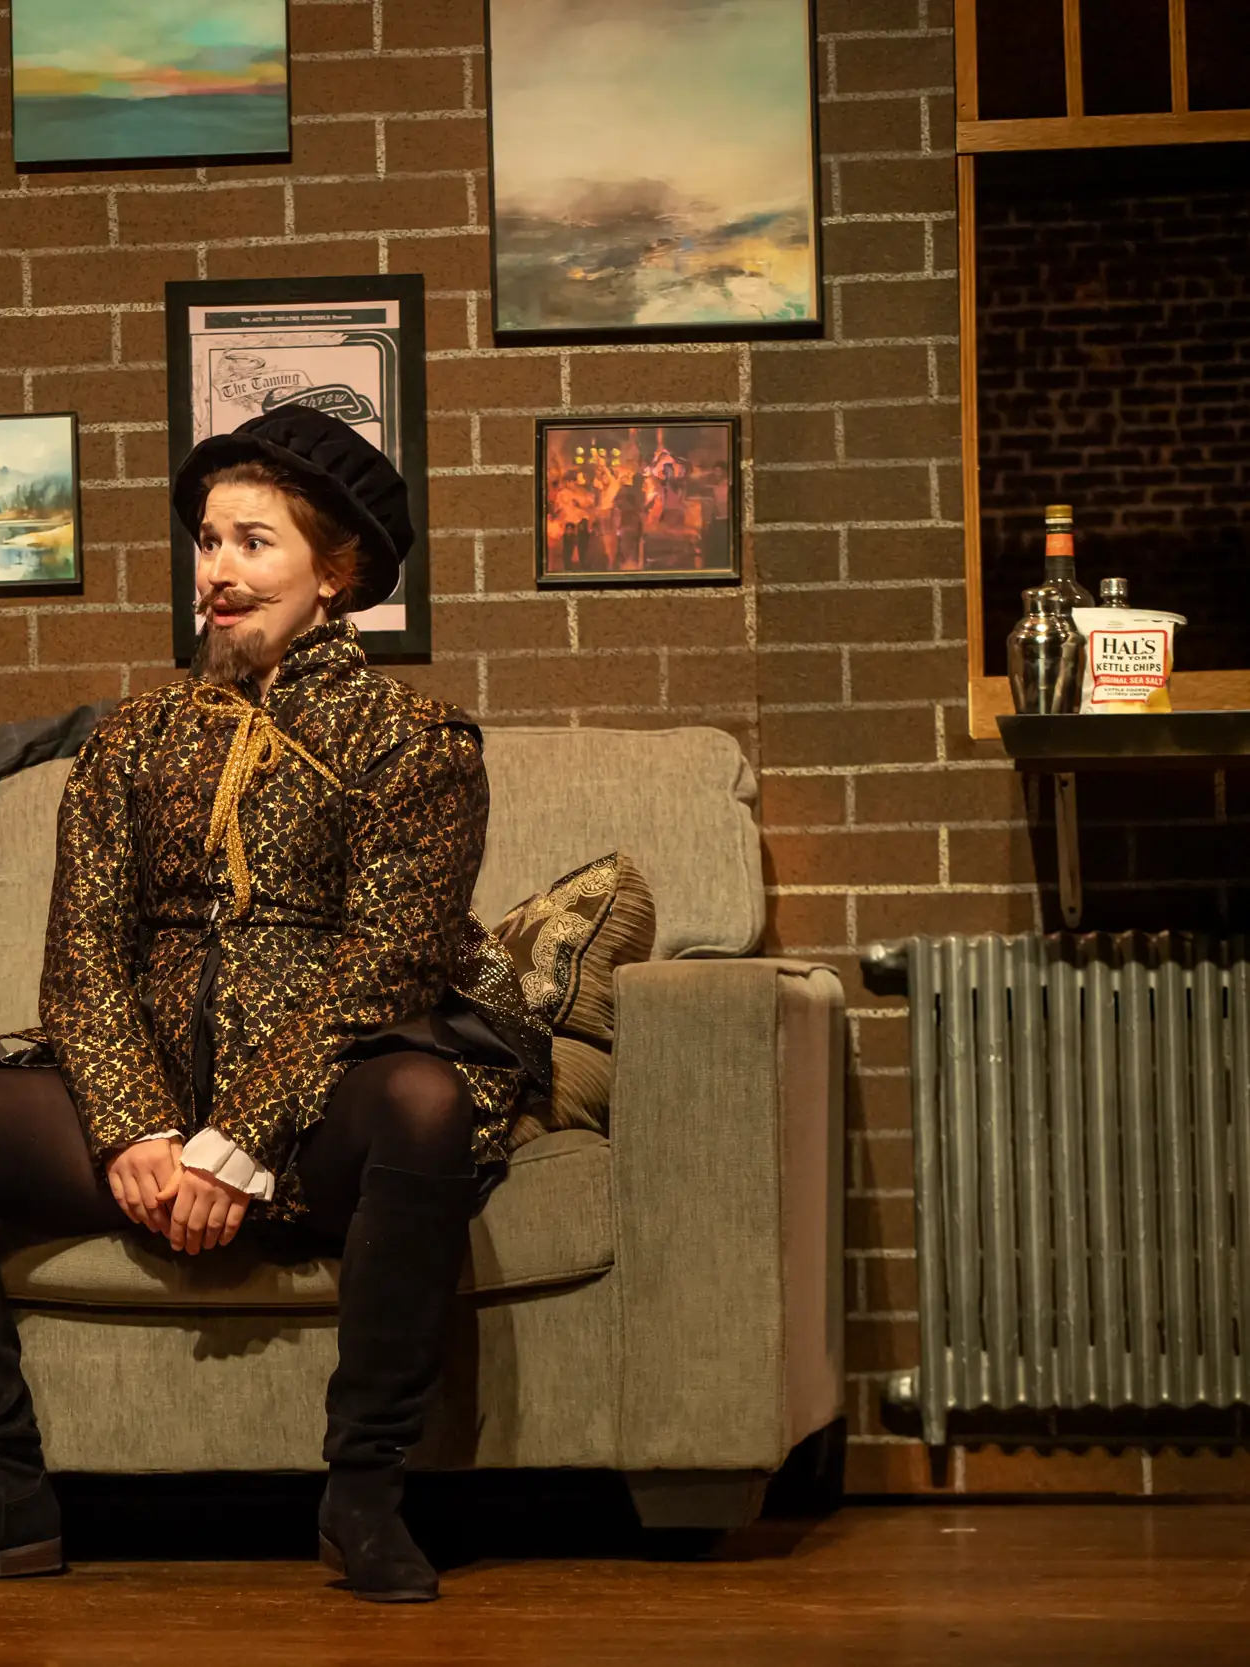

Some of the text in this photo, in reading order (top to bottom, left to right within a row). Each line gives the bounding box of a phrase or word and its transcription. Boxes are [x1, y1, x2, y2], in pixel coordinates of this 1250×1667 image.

[221, 373, 300, 398] The Taming
[1102, 637, 1156, 655] HAL'S
[1096, 662, 1162, 672] KETTLE CHIPS
[1129, 676, 1144, 685] SEA
[1145, 676, 1163, 686] SALT
